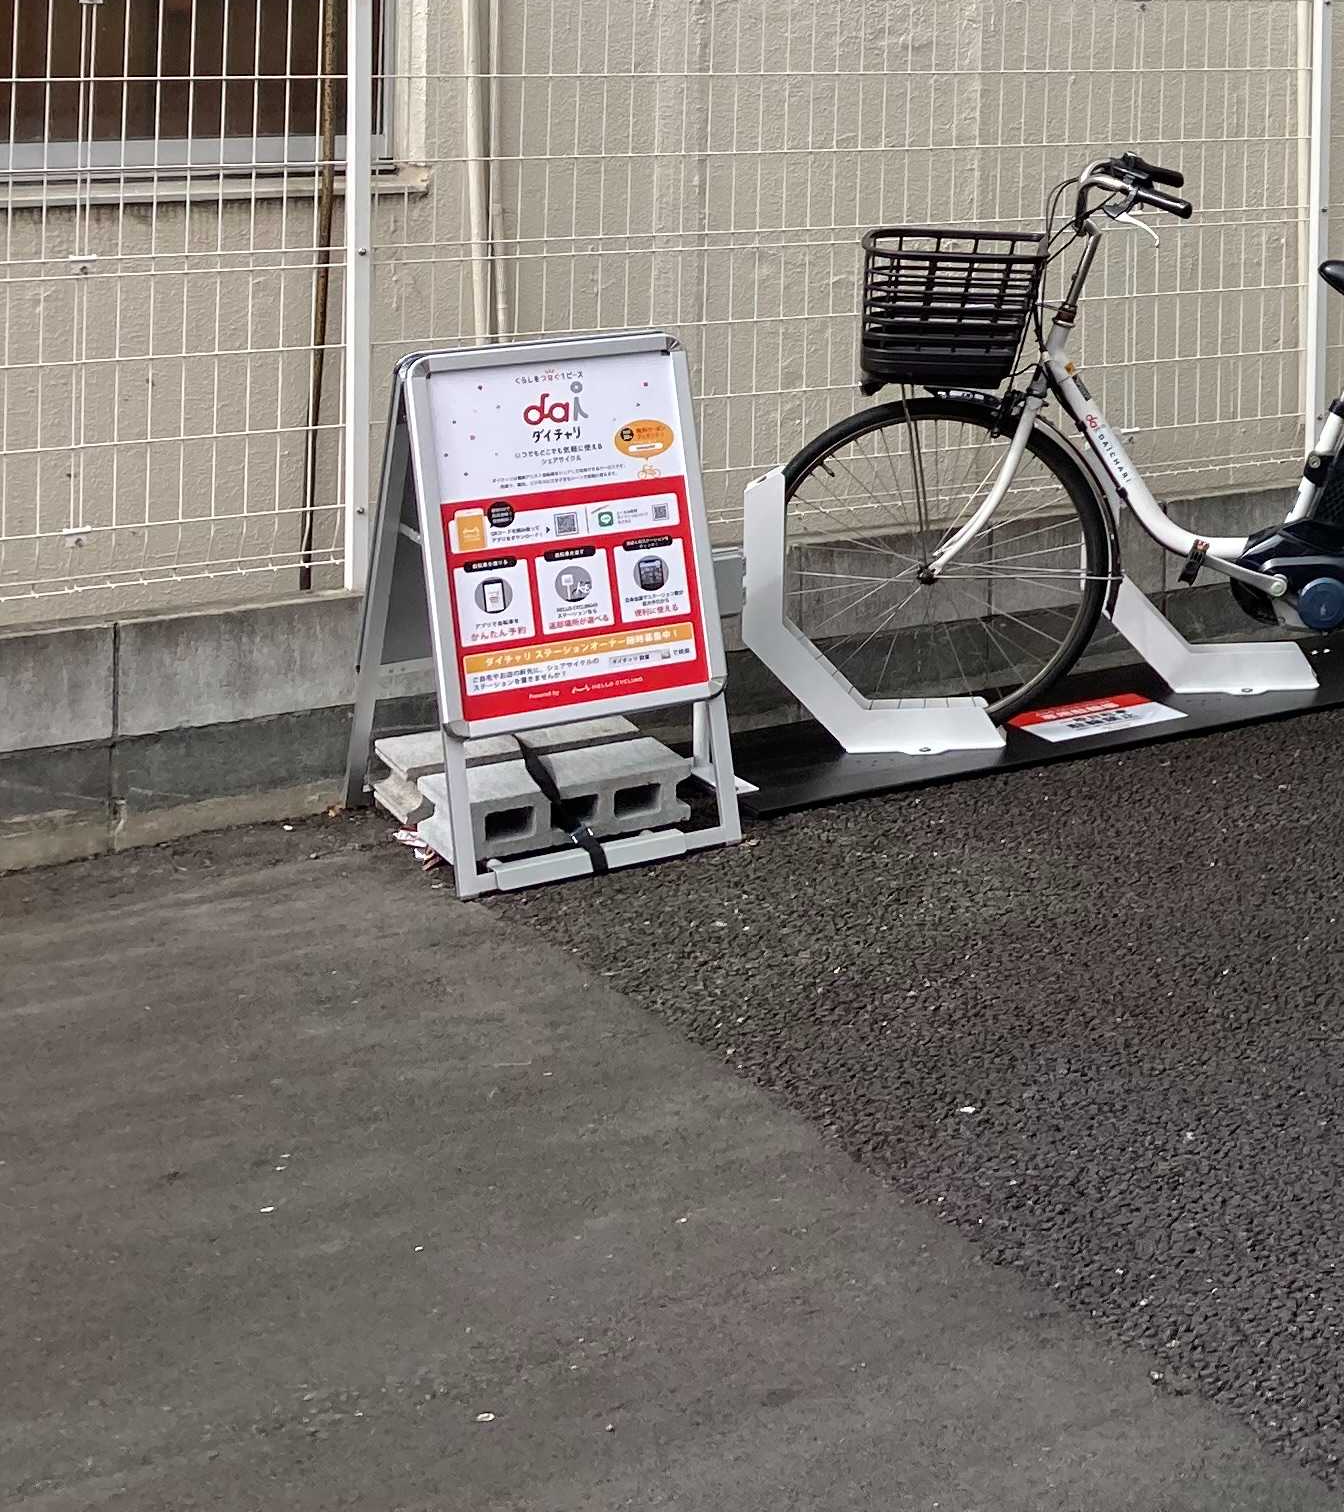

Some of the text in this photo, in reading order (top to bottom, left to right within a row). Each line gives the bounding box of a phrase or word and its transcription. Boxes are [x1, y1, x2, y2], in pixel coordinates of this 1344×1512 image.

[523, 381, 589, 426] dai
[532, 426, 581, 443] ダイチャリ
